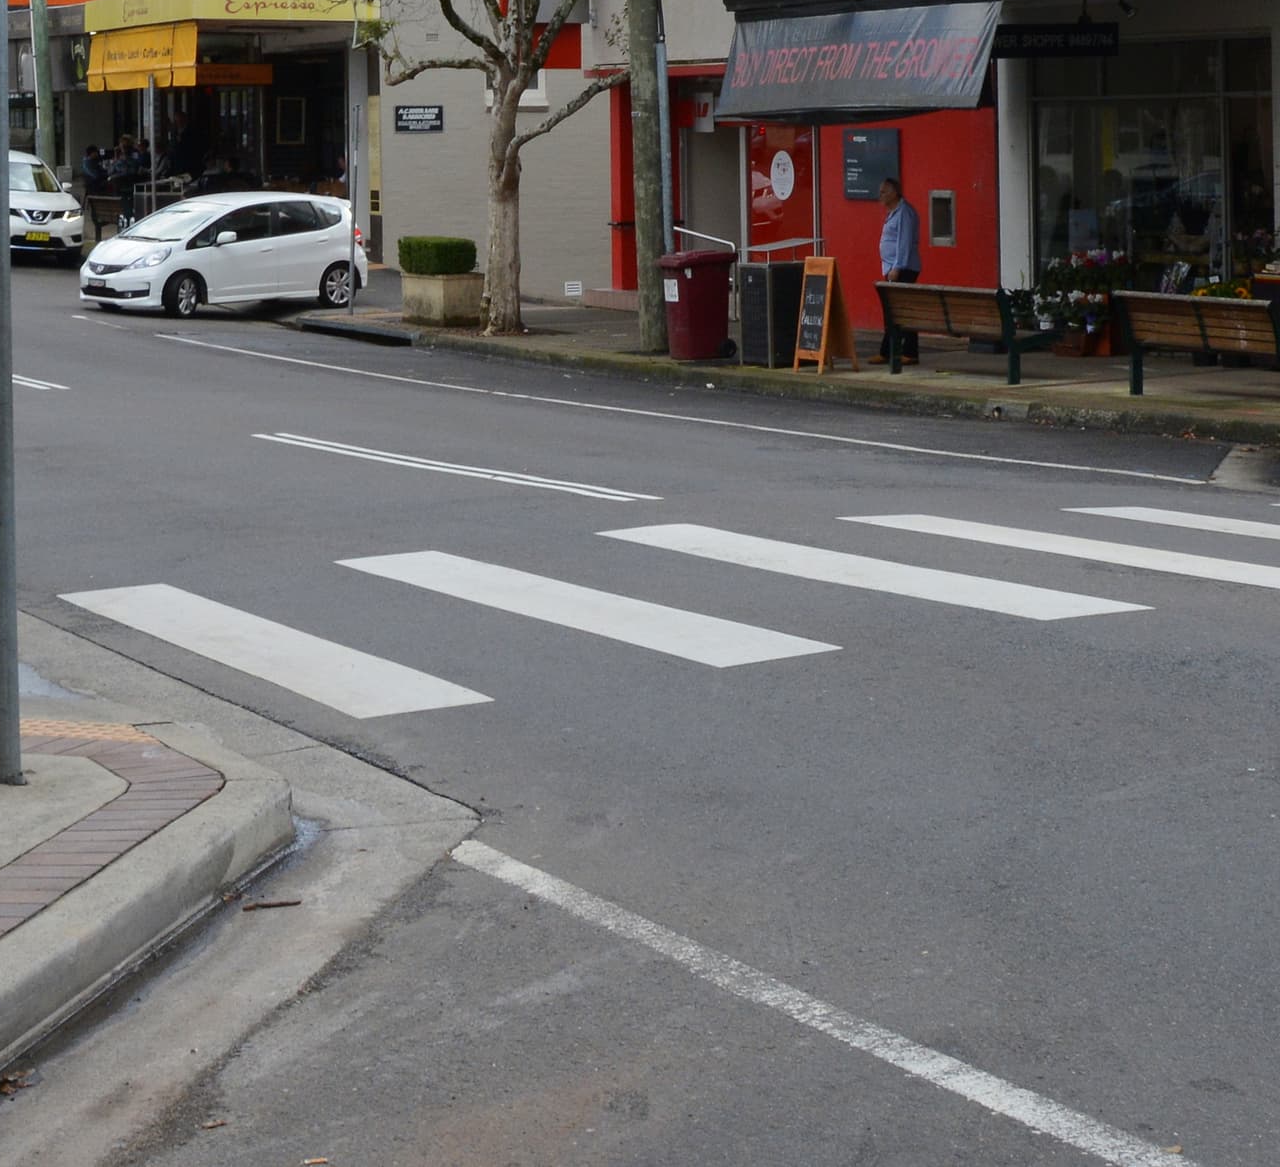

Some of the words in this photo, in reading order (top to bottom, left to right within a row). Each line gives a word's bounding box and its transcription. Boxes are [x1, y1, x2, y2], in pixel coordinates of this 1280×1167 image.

[731, 47, 762, 89] BUY
[759, 43, 818, 85] DIRECT
[815, 41, 866, 81] FROM
[860, 38, 895, 79] THE
[893, 36, 980, 79] GROWER
